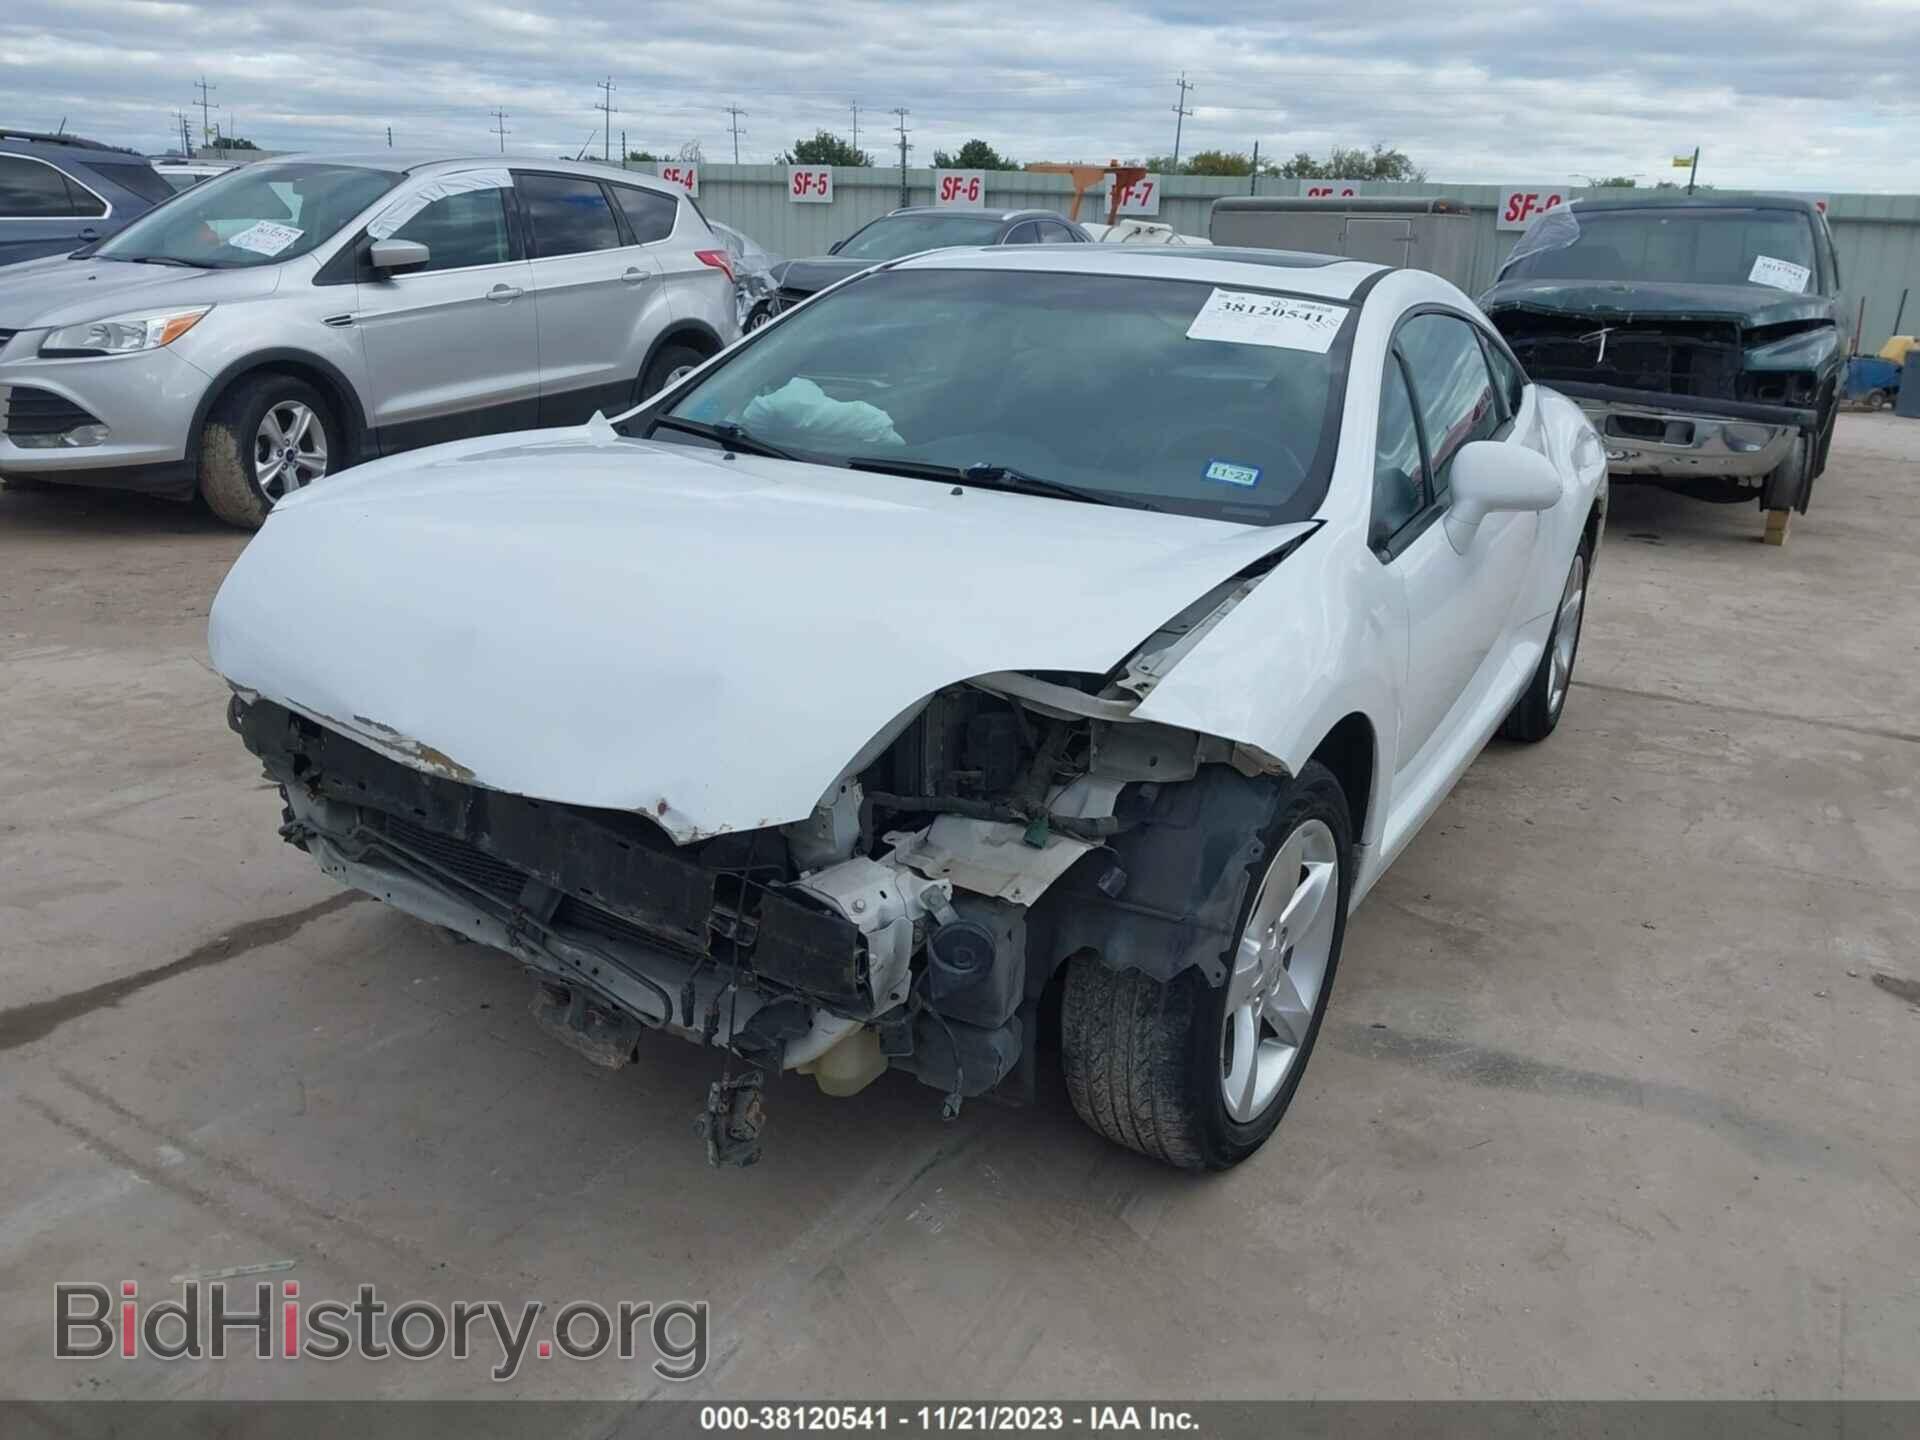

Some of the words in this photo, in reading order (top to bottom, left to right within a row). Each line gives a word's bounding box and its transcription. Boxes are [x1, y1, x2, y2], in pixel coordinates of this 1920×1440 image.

[793, 171, 828, 195] SF-5
[940, 176, 980, 201] SF-6
[1110, 182, 1154, 207] F-7
[1219, 301, 1325, 323] 38120541
